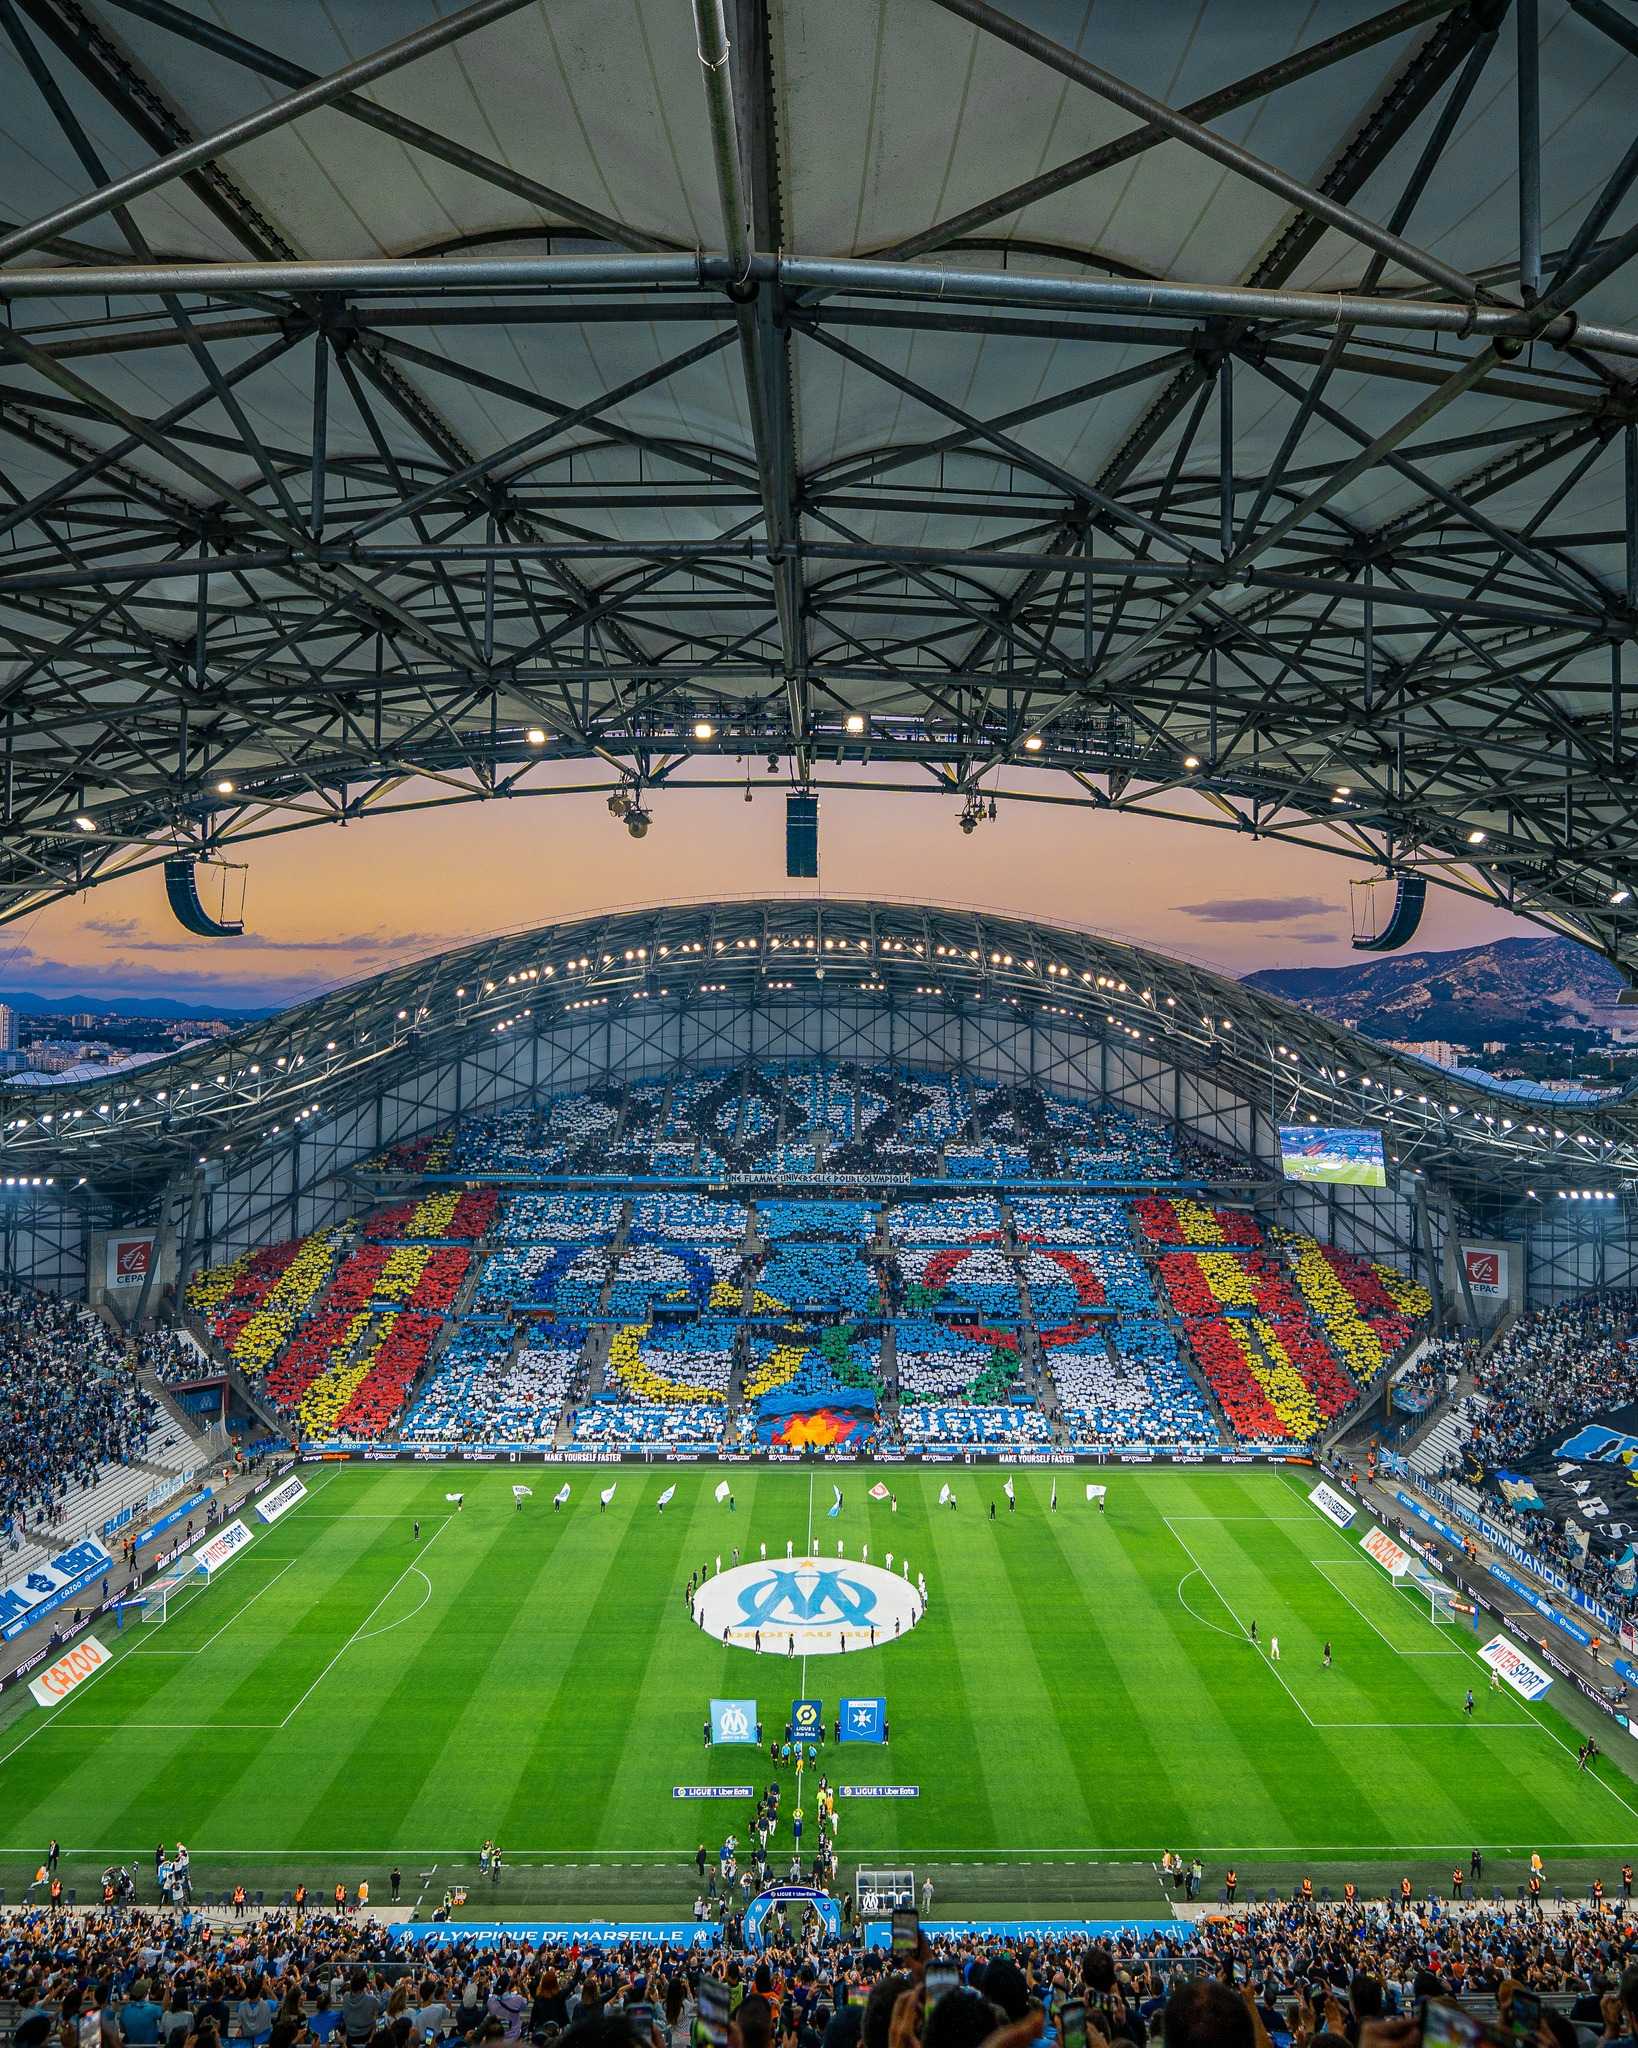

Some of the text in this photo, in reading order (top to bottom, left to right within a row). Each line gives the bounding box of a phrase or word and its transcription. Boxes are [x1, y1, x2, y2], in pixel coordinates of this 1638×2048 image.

[725, 1175, 741, 1183] UNE
[743, 1175, 778, 1183] FLAMME
[780, 1174, 832, 1183] UNIVERSELLE
[117, 1273, 147, 1284] CEPA
[1469, 1284, 1499, 1294] EPAC
[544, 1453, 622, 1462] MAKE YOURSELF FASTER
[999, 1455, 1075, 1464] MAKE YOURSELF FASTER
[205, 1525, 248, 1565] INTERSPORT
[51, 1541, 104, 1577] 1987
[1482, 1522, 1566, 1592] COMMANDO
[1492, 1565, 1511, 1583] CAZOO
[61, 1582, 81, 1599] CAZOO
[41, 1643, 102, 1696] CAZOO
[1493, 1643, 1545, 1692] INTERSPORT
[855, 1788, 914, 1796] LIGUE 1 Uber Eats
[424, 1931, 683, 1941] OLYMPIQUE DE MARSEILLE
